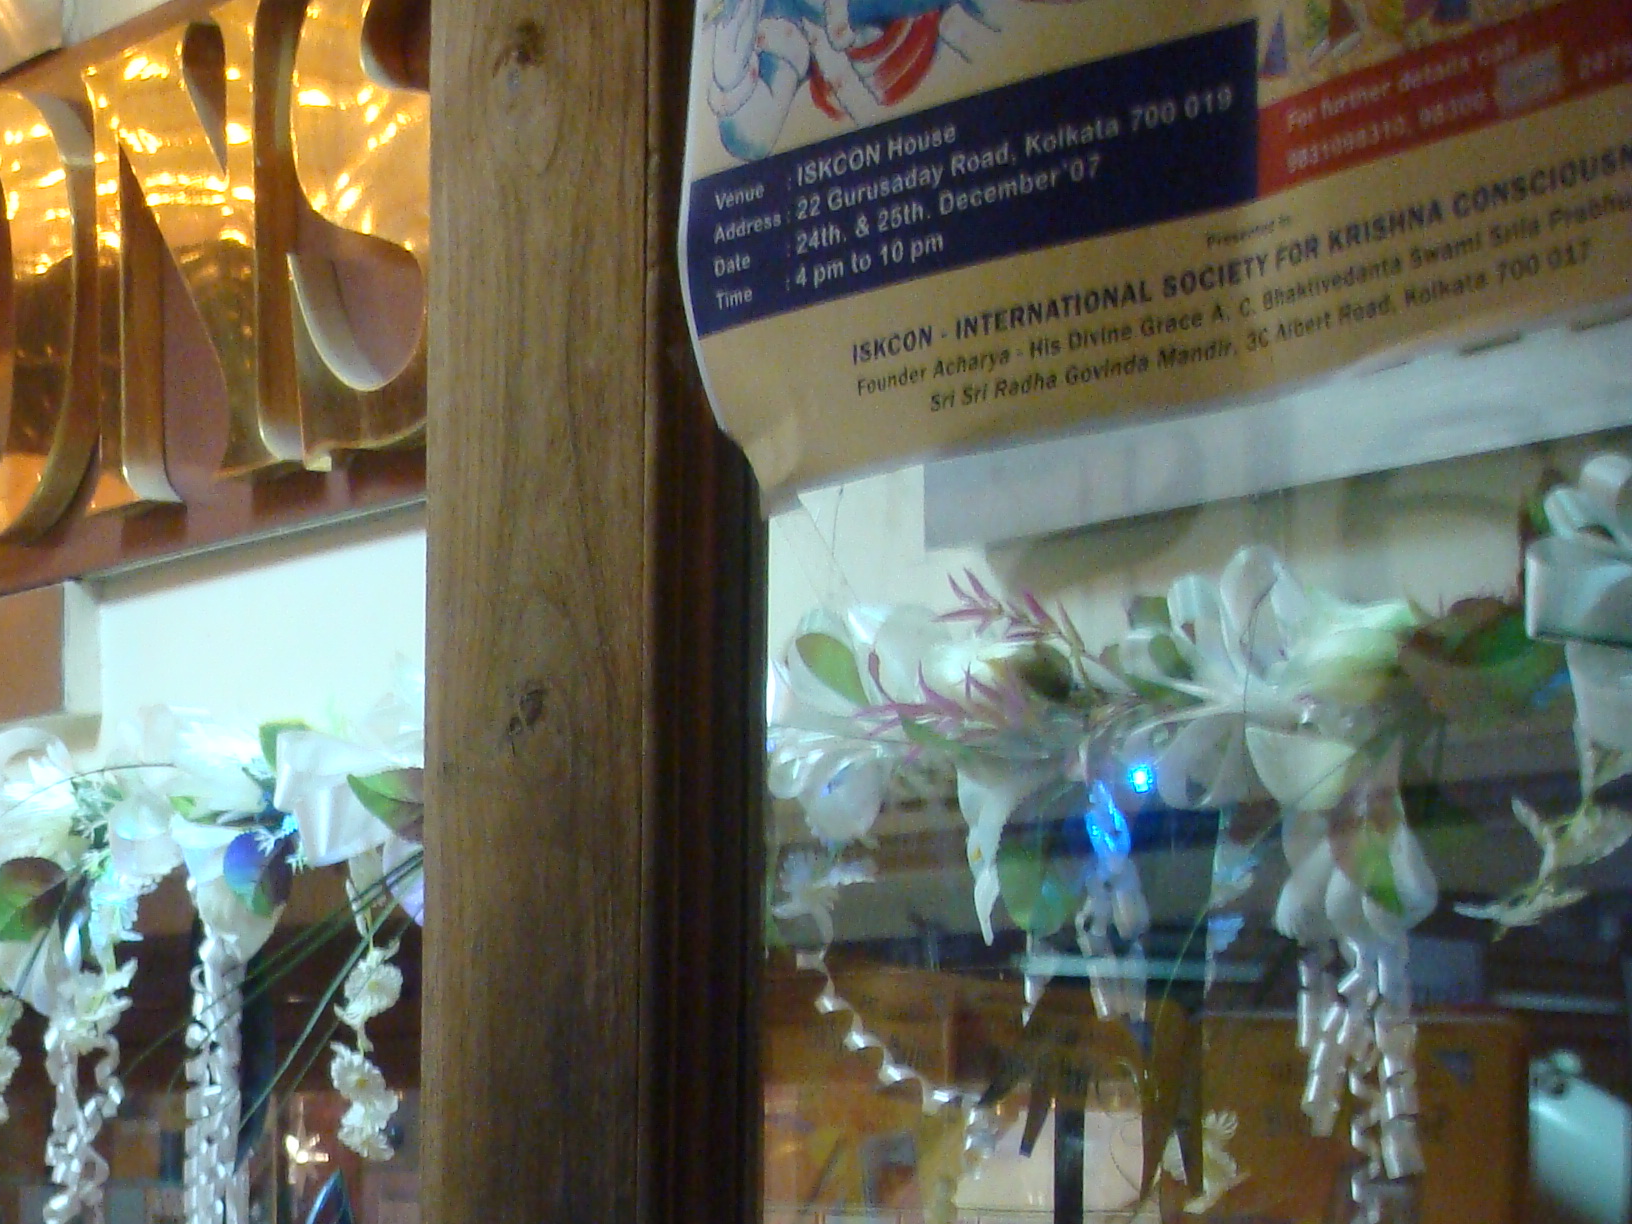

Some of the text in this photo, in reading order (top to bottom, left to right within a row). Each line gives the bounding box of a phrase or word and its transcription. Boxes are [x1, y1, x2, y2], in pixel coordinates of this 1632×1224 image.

[713, 212, 782, 245] Address
[796, 195, 821, 220] 22
[827, 164, 945, 211] Gurusaday
[1025, 117, 1119, 157] Kolkata
[1130, 102, 1176, 132] 700
[1183, 85, 1233, 120] 019
[714, 124, 956, 211] Venue ISKCON House
[713, 253, 751, 278] Date
[855, 216, 870, 238] &
[715, 231, 944, 311] Time 4 pm to 10 pm
[852, 324, 933, 366] ISKCON
[956, 279, 1153, 340] INTERNATIONAL
[1163, 252, 1269, 299] SOCIETY
[1275, 233, 1319, 271] FOR
[1328, 200, 1443, 252] KRISHNA
[857, 365, 927, 396] Founder
[933, 347, 1011, 381] Acharya
[1029, 336, 1062, 360] His
[1068, 321, 1133, 351] Divine
[1140, 310, 1203, 338] Grace
[1263, 255, 1402, 311] Bhaktivedanta
[1410, 231, 1482, 269] Swami
[930, 390, 955, 412] Sri
[961, 382, 988, 407] Sri
[994, 372, 1058, 400] Radha
[1065, 354, 1149, 386] Govinda
[1277, 310, 1331, 343] Albert
[1404, 271, 1487, 307] Kolkata
[1496, 253, 1540, 285] 700
